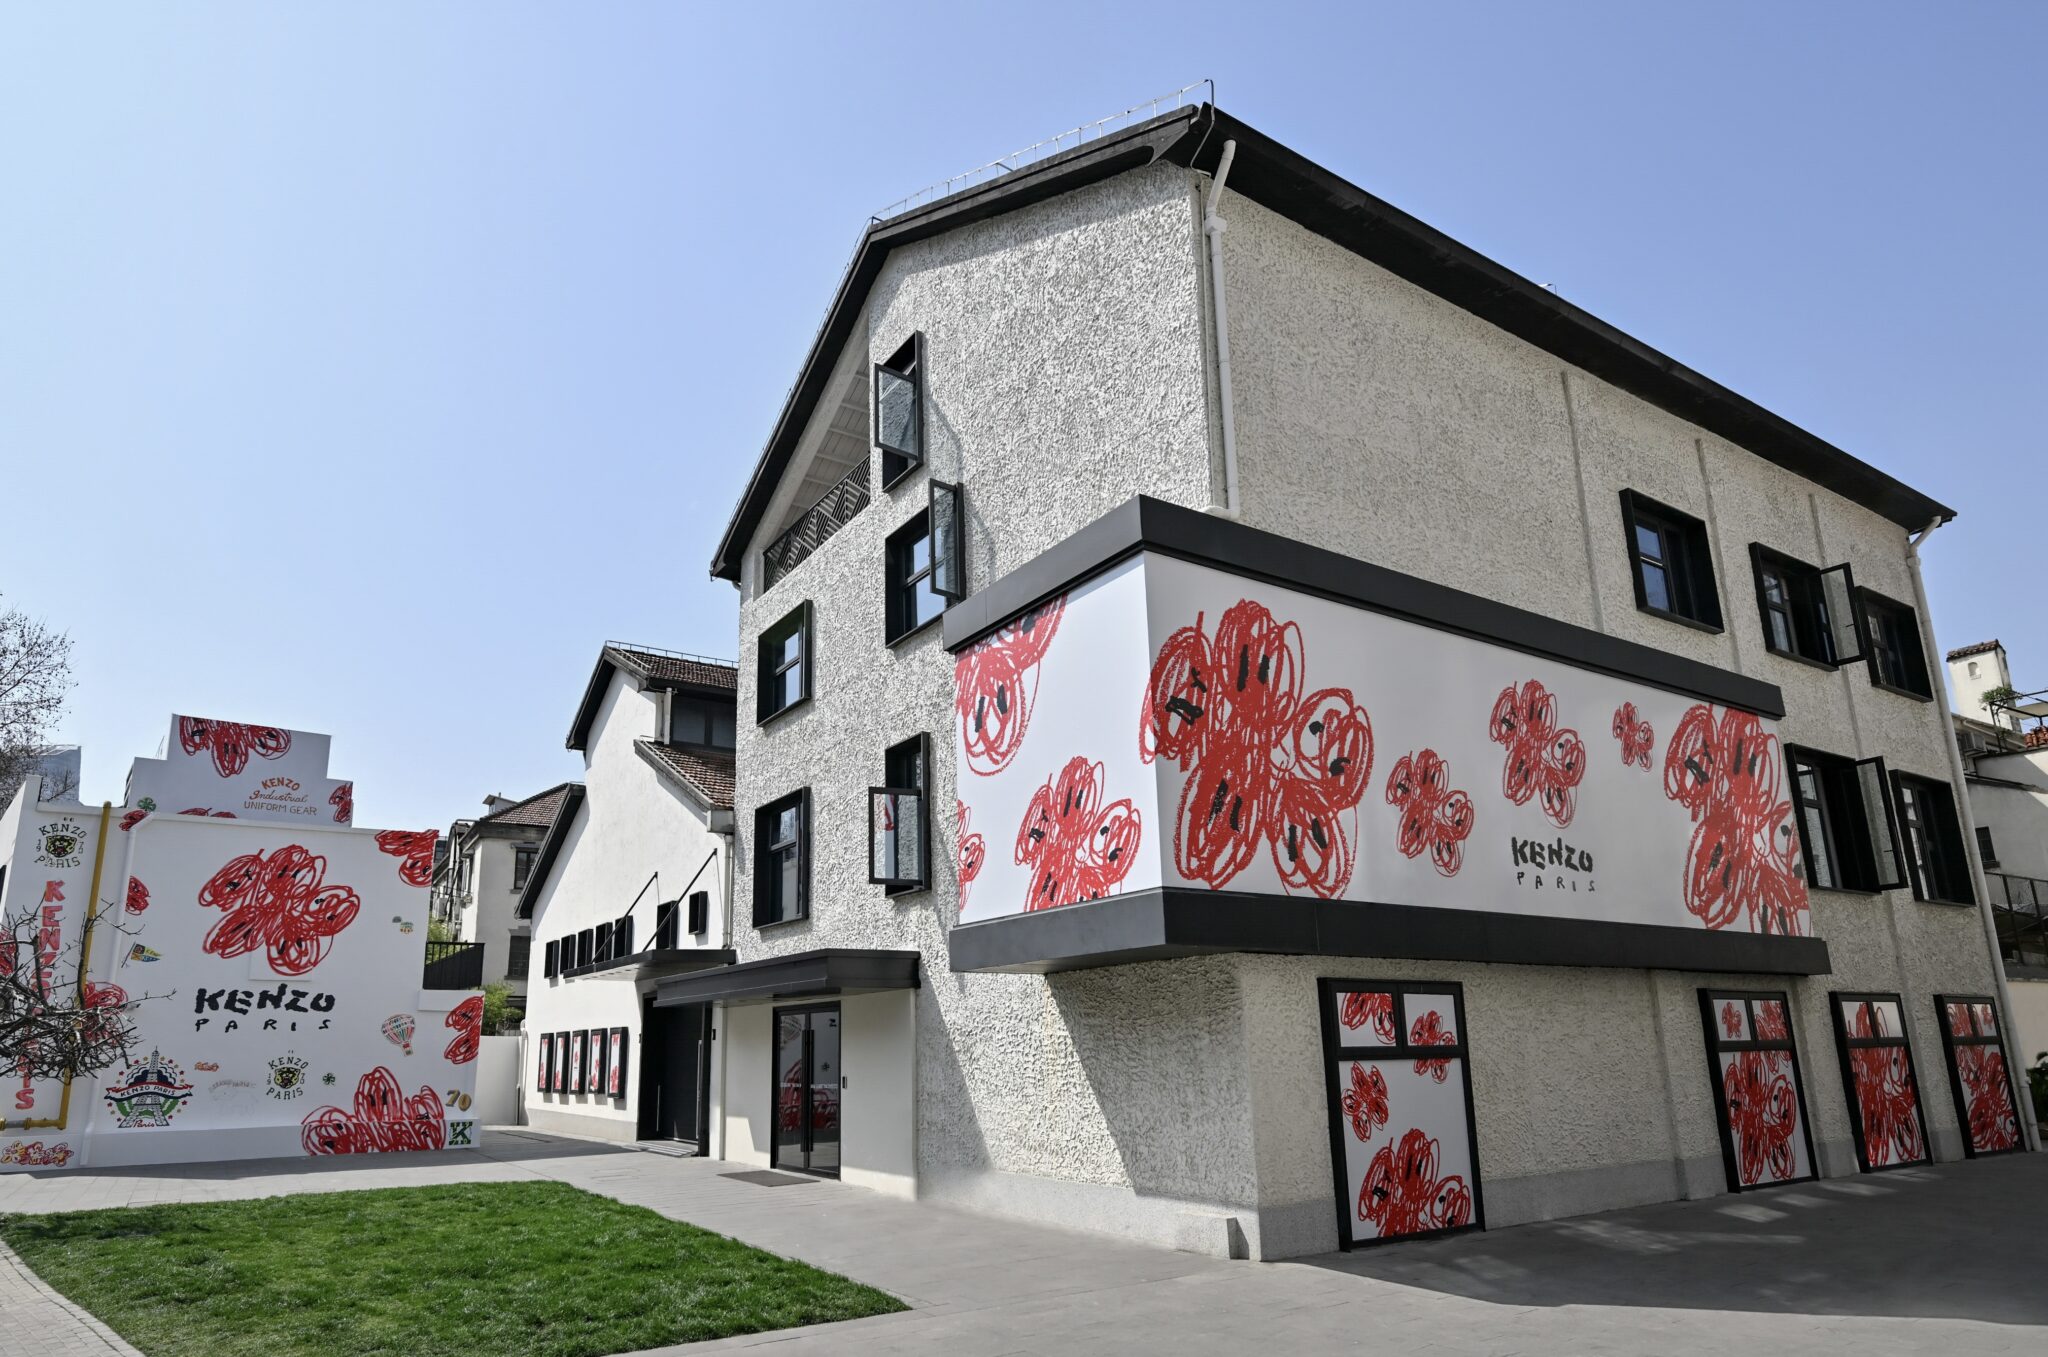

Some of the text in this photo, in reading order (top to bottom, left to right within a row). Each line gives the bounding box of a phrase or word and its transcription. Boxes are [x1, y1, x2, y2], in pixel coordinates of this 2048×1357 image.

[261, 777, 300, 791] KENZO
[249, 790, 308, 803] Industrial
[244, 801, 317, 815] UNIFORM GEAR
[38, 823, 87, 838] KENZO
[34, 855, 80, 868] PARIS
[1512, 837, 1593, 872] KENZO
[1517, 872, 1595, 892] PARIS
[195, 983, 335, 1015] KENZO
[195, 1018, 331, 1033] PARIS
[268, 1056, 309, 1070] KENZO
[121, 1085, 176, 1097] KENZO PARIS
[266, 1087, 304, 1100] PARIS
[446, 1090, 472, 1111] 70
[133, 1119, 155, 1128] Paris
[449, 1121, 473, 1145] K
